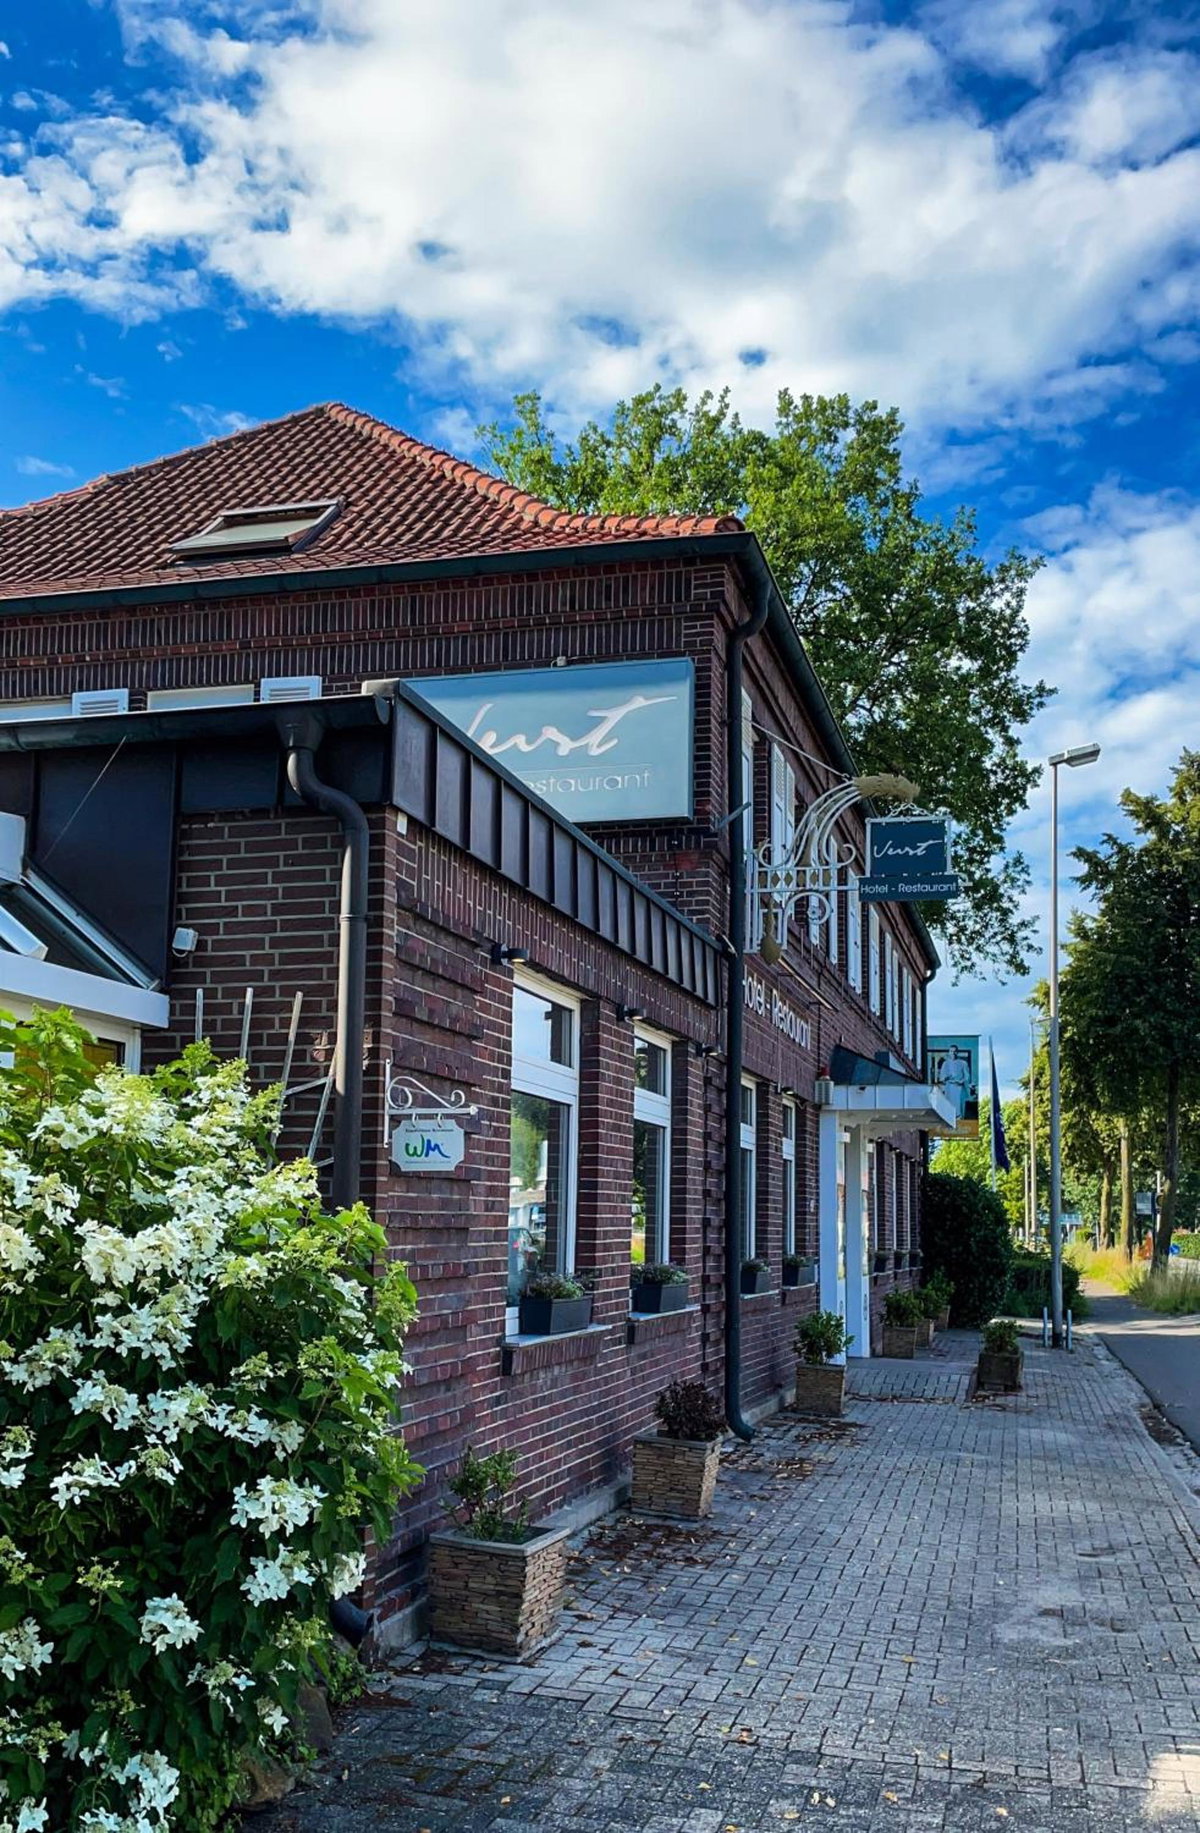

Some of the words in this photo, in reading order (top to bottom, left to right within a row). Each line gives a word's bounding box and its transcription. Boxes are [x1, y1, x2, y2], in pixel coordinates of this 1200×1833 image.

[524, 770, 650, 794] estaurant
[860, 883, 889, 894] Hotel
[898, 882, 957, 893] Restaurant
[772, 988, 811, 1051] Restaurant
